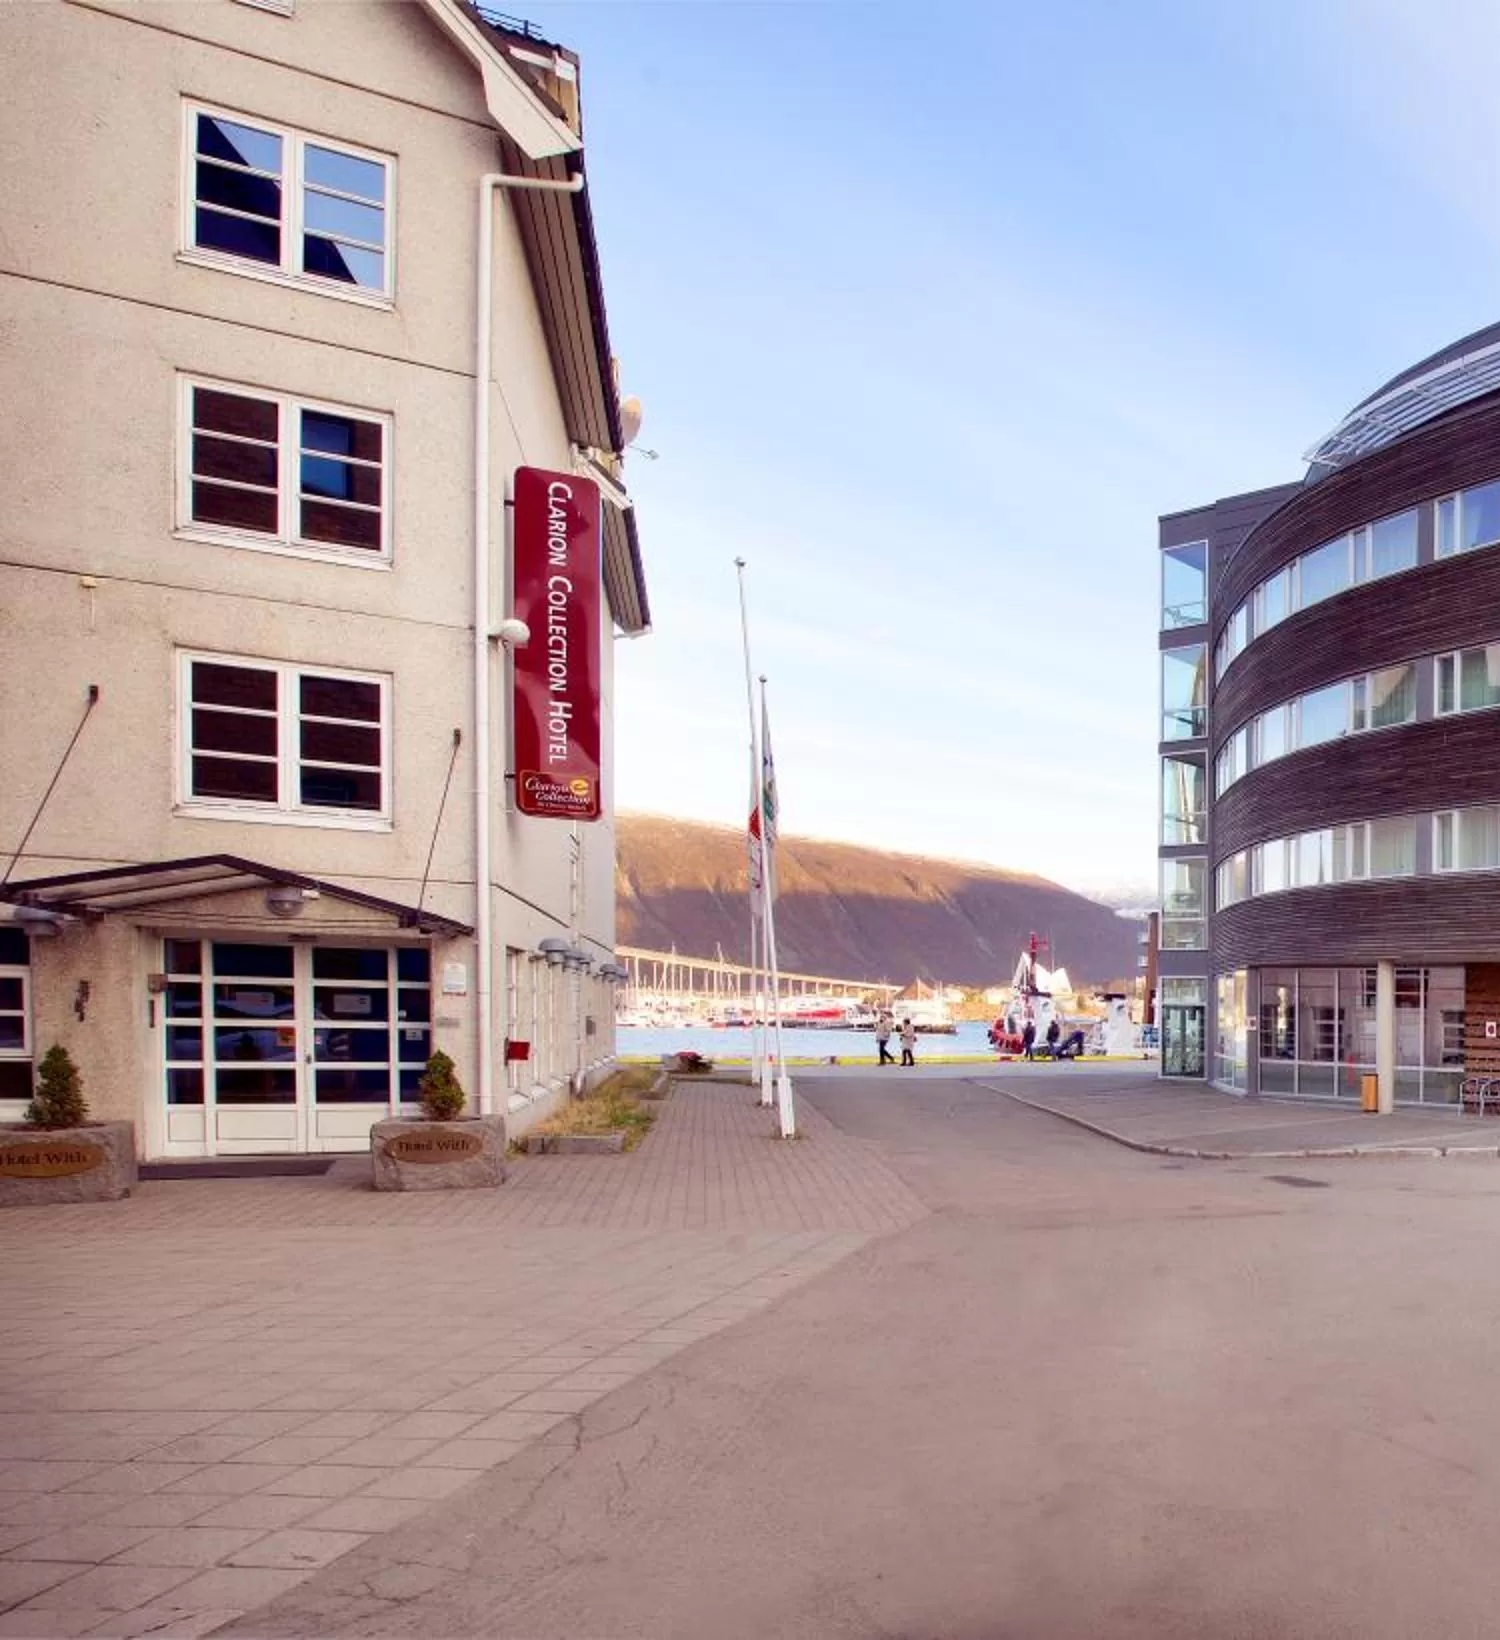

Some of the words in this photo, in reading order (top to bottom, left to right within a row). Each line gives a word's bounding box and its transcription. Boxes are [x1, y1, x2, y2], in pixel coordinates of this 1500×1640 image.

[548, 481, 572, 566] CLARION
[548, 576, 572, 692] COLLECTION
[549, 700, 572, 763] HOTEL
